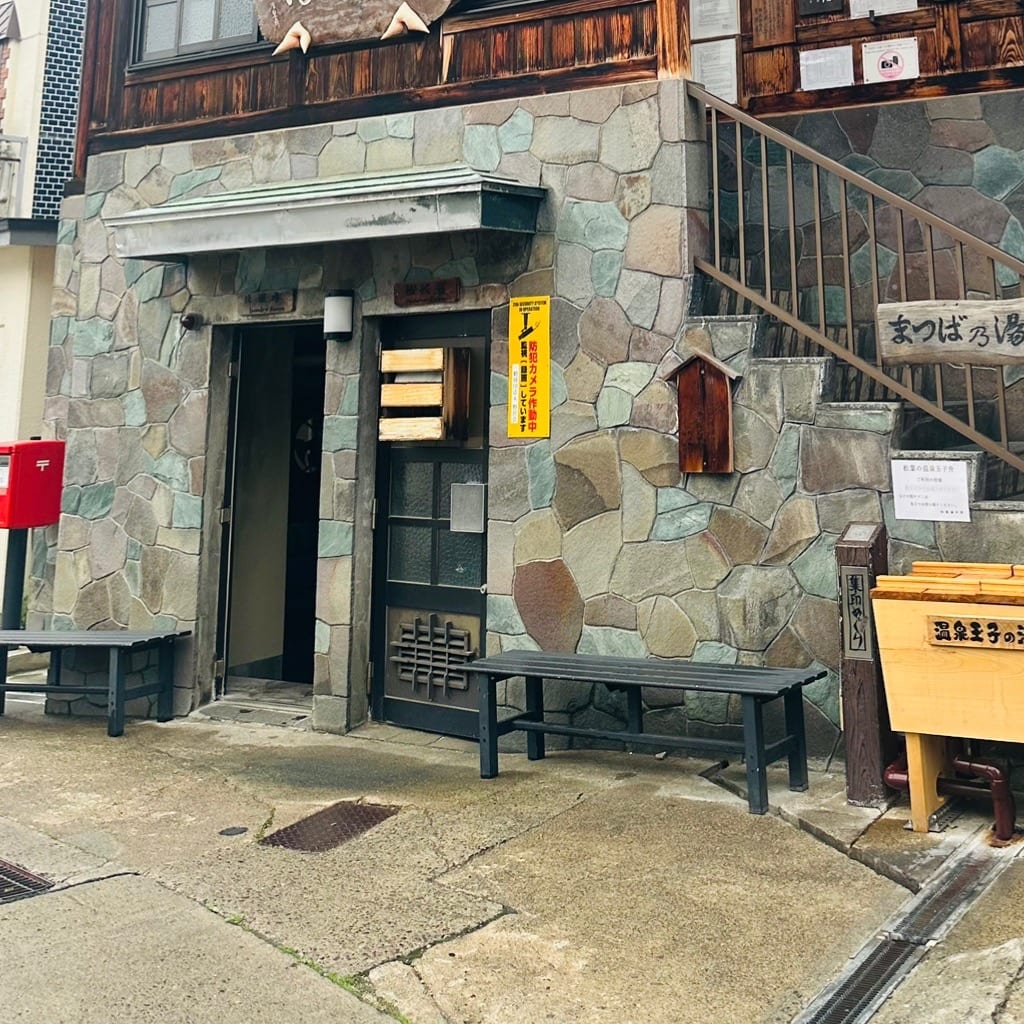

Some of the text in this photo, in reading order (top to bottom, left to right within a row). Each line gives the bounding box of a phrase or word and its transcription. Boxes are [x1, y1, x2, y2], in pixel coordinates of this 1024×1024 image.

[528, 341, 538, 433] 防犯カメラ作動中
